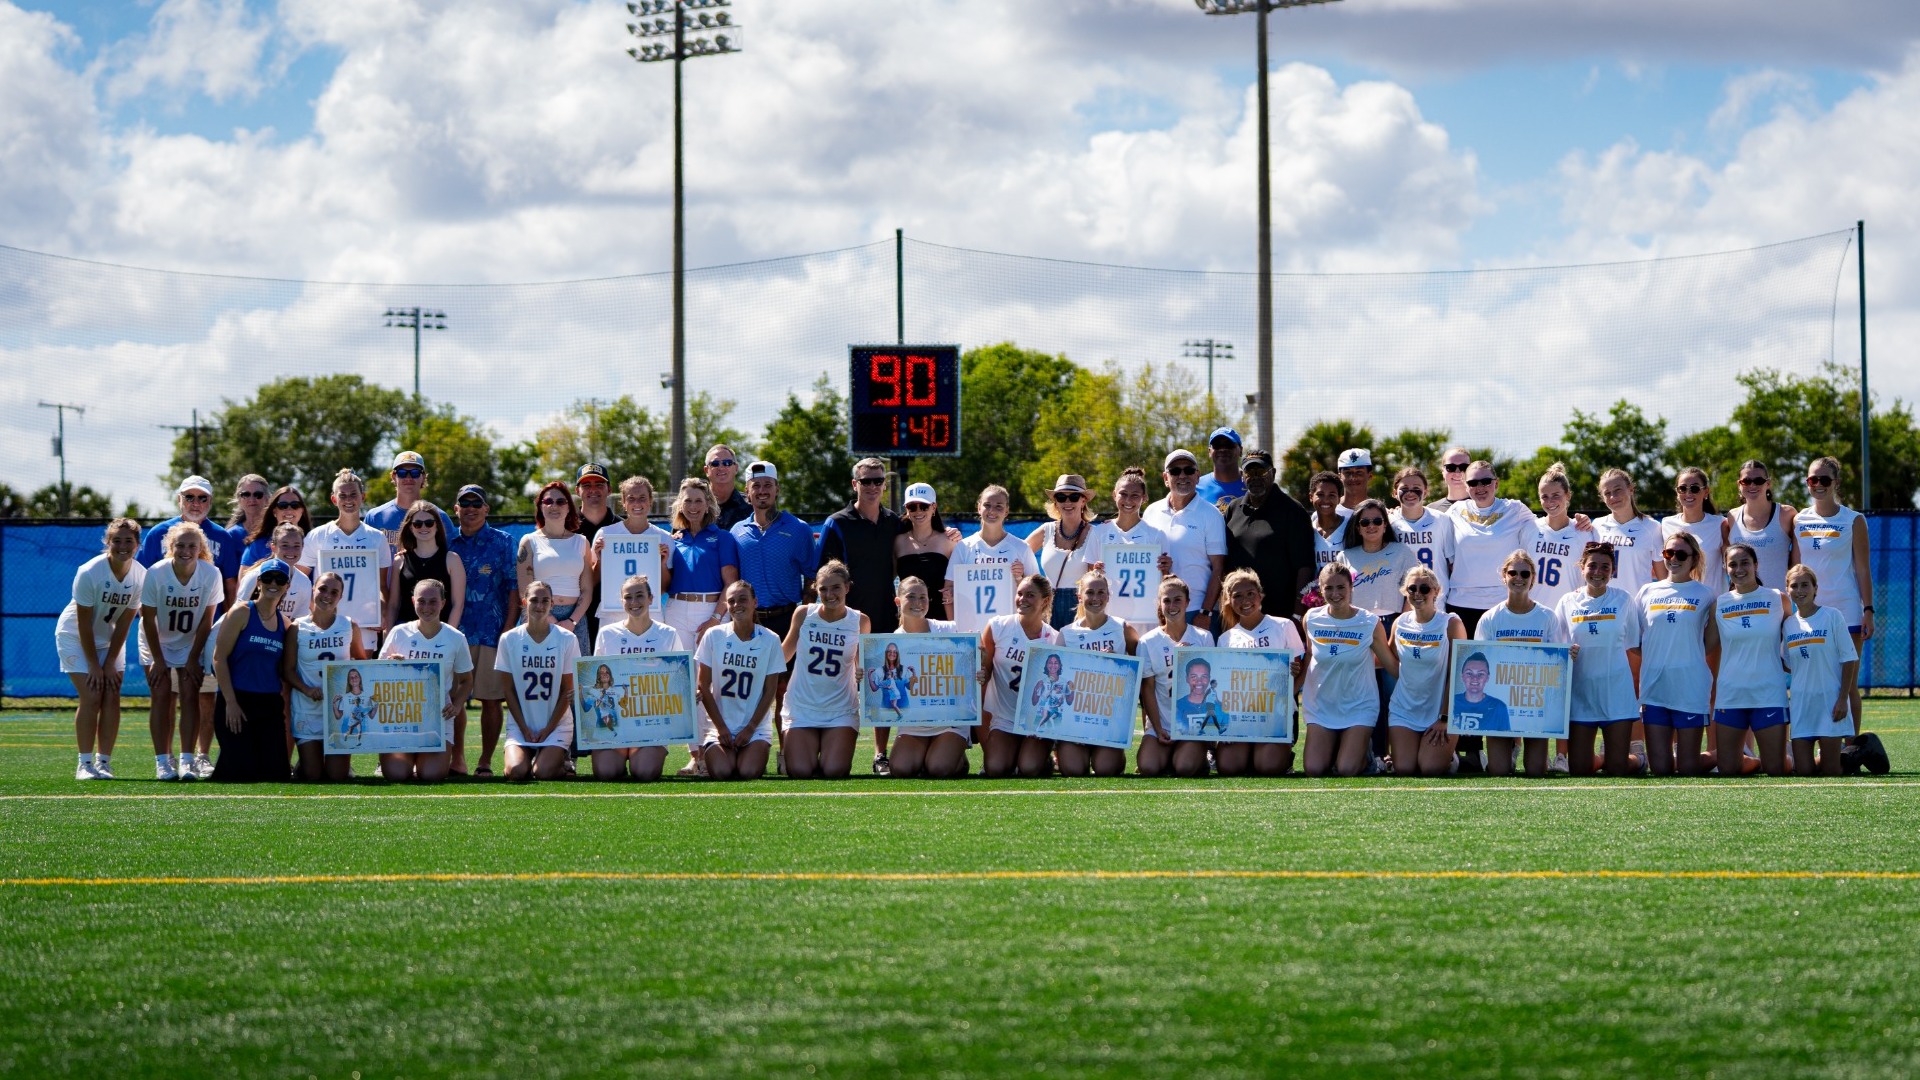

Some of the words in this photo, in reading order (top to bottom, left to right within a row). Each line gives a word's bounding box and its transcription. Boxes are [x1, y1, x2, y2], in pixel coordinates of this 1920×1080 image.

[870, 355, 936, 406] 90
[613, 542, 649, 554] EAGLES
[1116, 552, 1152, 564] EAGLES
[1316, 551, 1341, 563] AGLE
[1535, 541, 1571, 557] EAGLES
[331, 555, 367, 570] EAGLES
[624, 559, 637, 576] 0
[1537, 557, 1562, 587] 16
[967, 568, 1003, 581] EAGLES
[1118, 569, 1146, 598] 23
[1353, 566, 1392, 588] Eagles
[343, 573, 356, 601] 7
[101, 591, 132, 606] EAGLES
[165, 595, 200, 608] EAGLES
[279, 600, 296, 613] GLES
[975, 585, 997, 614] 12
[1721, 601, 1771, 614] EMBRY-RIDDLE
[168, 609, 195, 634] 10
[308, 636, 344, 650] EAGLES
[809, 630, 846, 647] EAGLES
[1314, 629, 1364, 641] EMBRY-RIDDLE
[1400, 631, 1444, 642] EMBRY-RIDDLE
[1496, 629, 1544, 638] EMBRY-RIDDLE
[522, 655, 556, 668] EAGLES
[723, 652, 758, 669] EAGLES
[807, 646, 845, 678] 25
[1006, 646, 1025, 662] EAG
[920, 655, 954, 675] LEAH
[1495, 663, 1562, 688] MADELINE
[523, 671, 553, 701] 29
[629, 674, 670, 697] EMILY
[721, 668, 754, 700] 20
[909, 675, 965, 697] COLETTI
[1069, 670, 1127, 697] JORDAN
[1230, 670, 1270, 691] RYLIE
[373, 681, 427, 703] ABIGAIL
[1221, 690, 1277, 714] BRYANT
[1509, 686, 1544, 707] NEES
[378, 703, 423, 724] OZGAR
[618, 694, 683, 718] SILLIMAN
[1073, 691, 1115, 718] DAVIS
